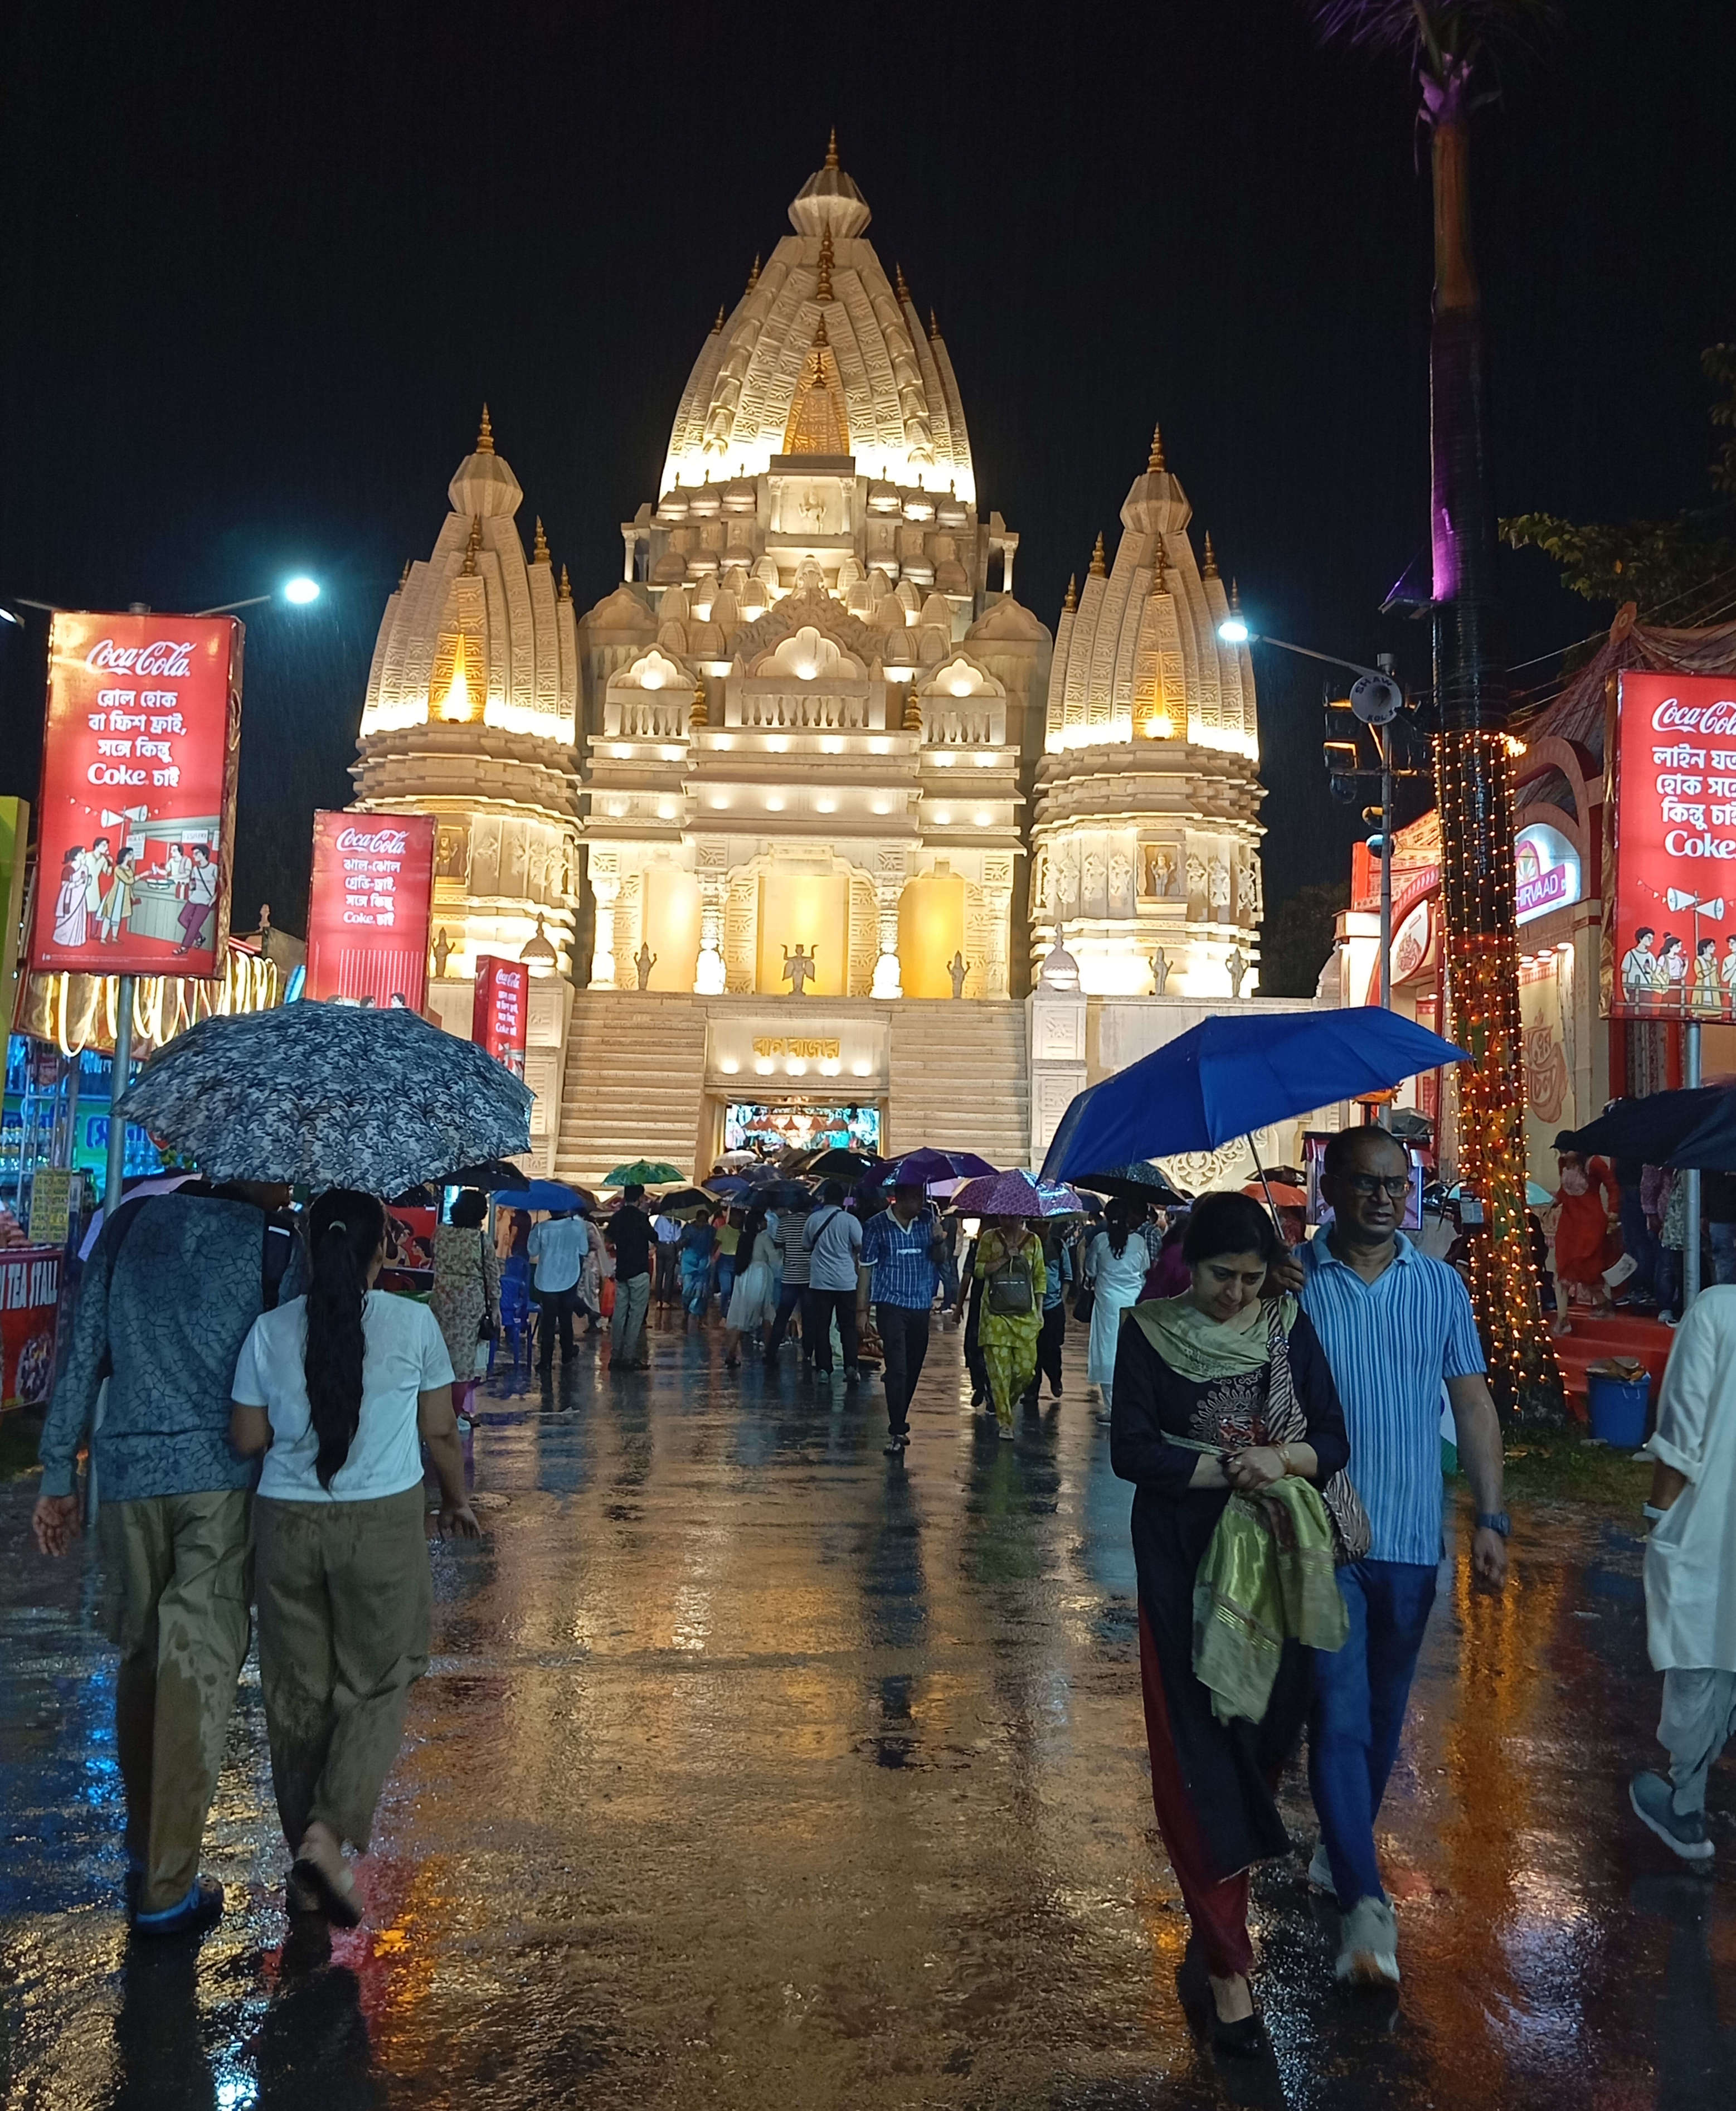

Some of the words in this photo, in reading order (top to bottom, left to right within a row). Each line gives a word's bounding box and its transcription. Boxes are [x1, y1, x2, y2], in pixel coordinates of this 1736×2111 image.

[86, 639, 197, 677] Coca-Cola
[98, 689, 137, 707] রোল
[140, 691, 178, 707] হোক
[1355, 677, 1392, 694] SHAW
[88, 713, 106, 731] বা
[109, 710, 147, 731] ফিশ
[149, 713, 187, 735] ফ্রাই,
[1652, 698, 1736, 735] Coca-Col
[1652, 744, 1706, 769] লাইন
[87, 763, 146, 785] Coke
[152, 766, 181, 787] চাই
[1656, 773, 1703, 795] হোক
[1661, 796, 1708, 830] কিন্তু
[336, 828, 410, 854] Coca-Cola
[1665, 829, 1736, 859] Coke
[1516, 874, 1558, 907] HIRVAAD
[343, 911, 374, 924] Coke
[7, 1263, 27, 1310] TEA
[29, 1260, 58, 1310] STALL
